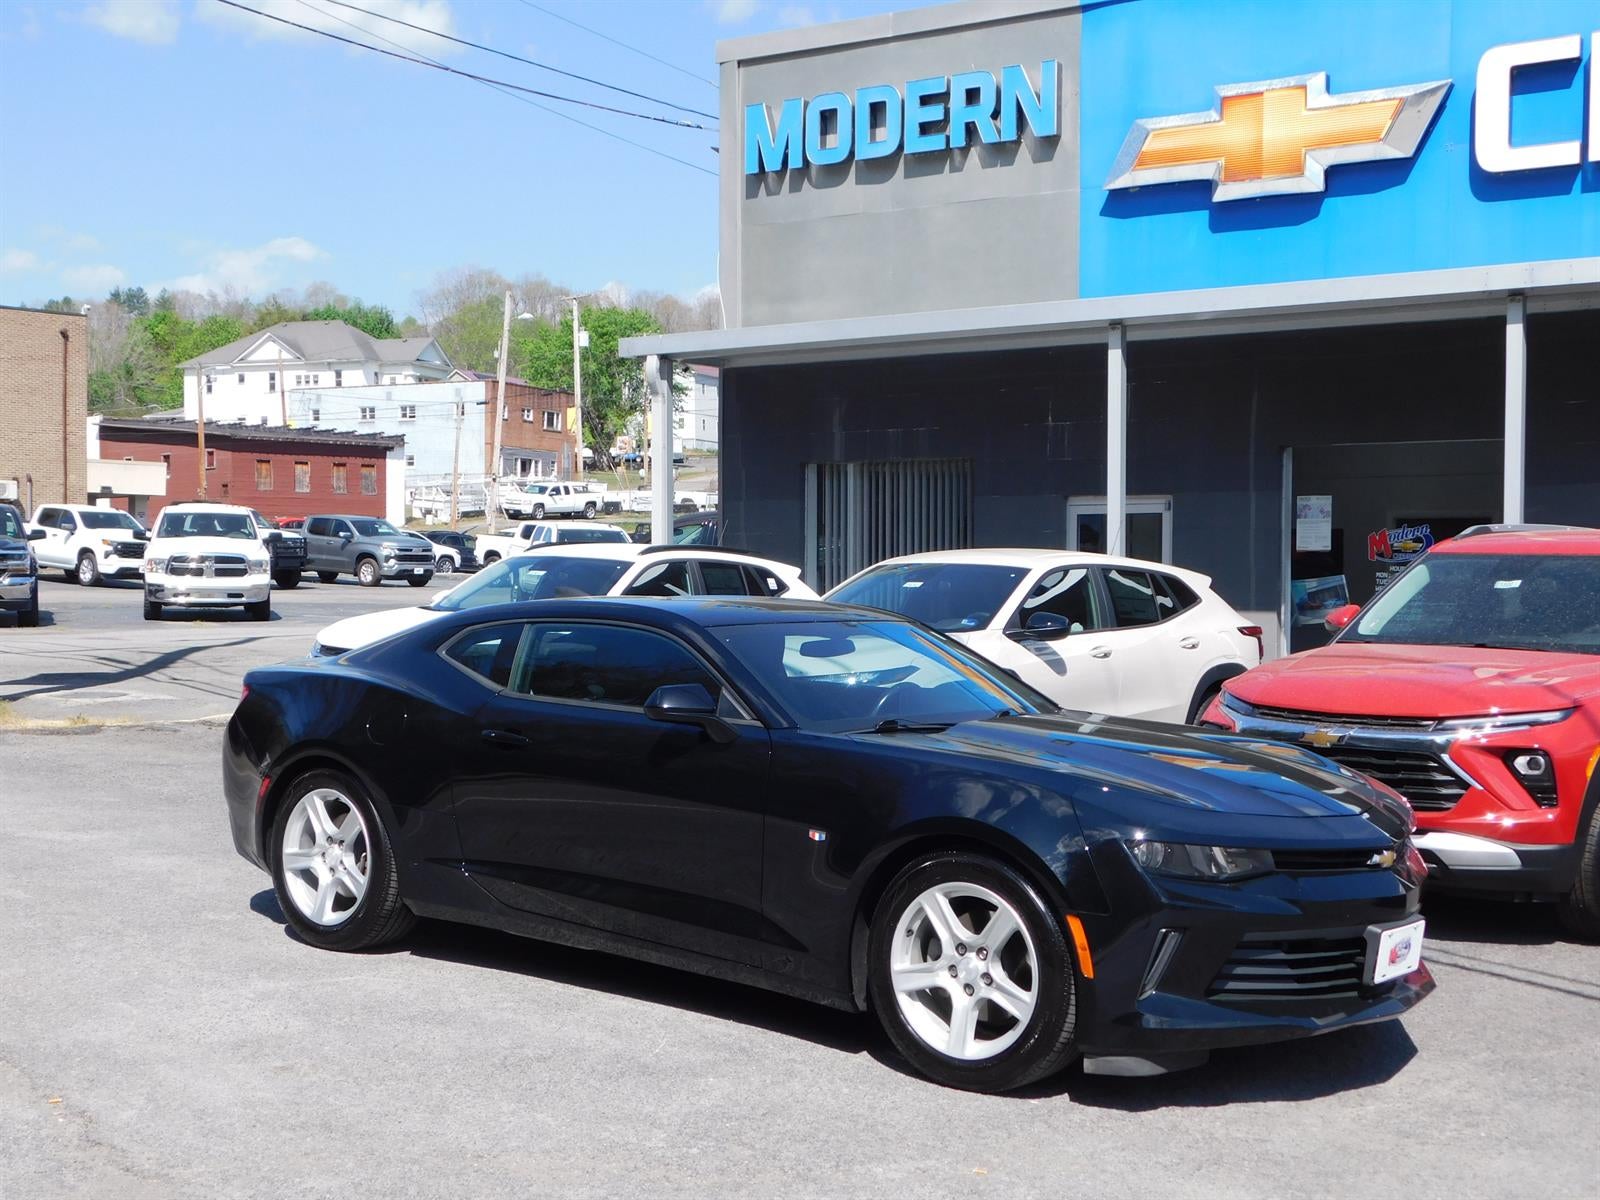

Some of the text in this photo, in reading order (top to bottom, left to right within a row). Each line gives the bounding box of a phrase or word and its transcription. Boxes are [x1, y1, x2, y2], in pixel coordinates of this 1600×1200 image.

[744, 59, 1059, 174] MODERN
[1475, 31, 1600, 172] C
[1368, 524, 1430, 561] Modern
